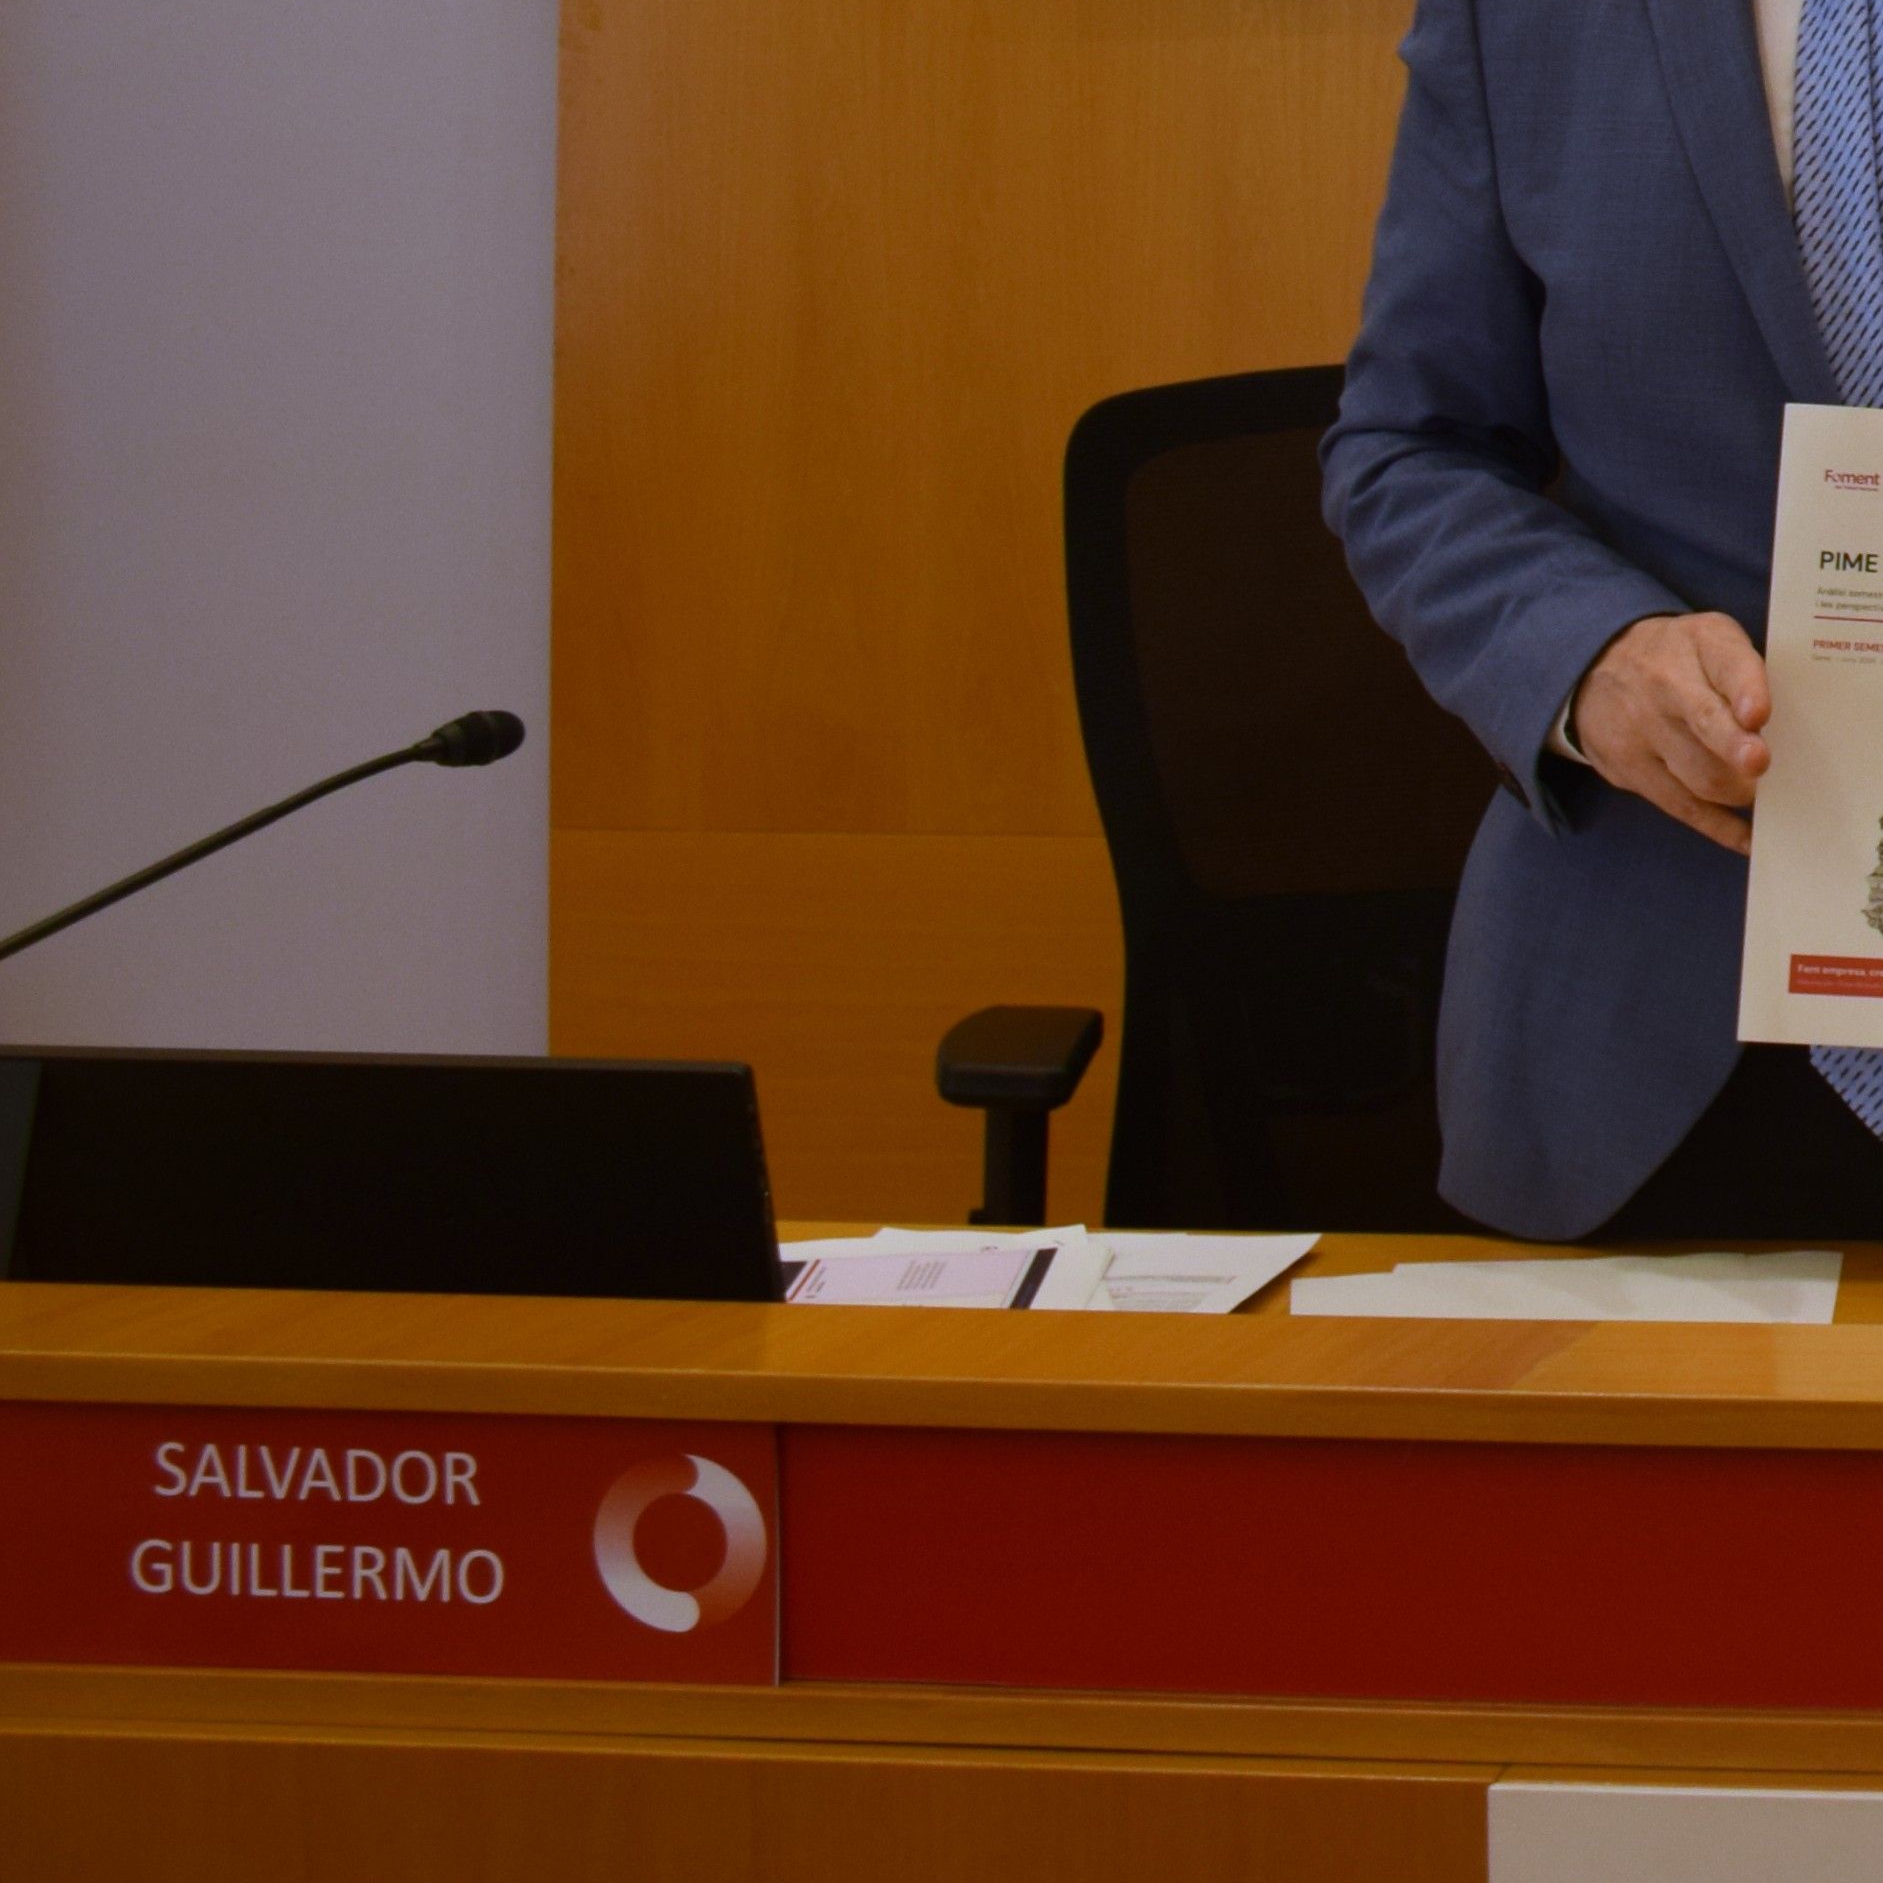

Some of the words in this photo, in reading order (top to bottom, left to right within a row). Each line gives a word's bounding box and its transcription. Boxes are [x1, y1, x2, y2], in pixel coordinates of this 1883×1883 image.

[1820, 551, 1879, 573] PIME
[1813, 639, 1852, 651] PRIMER
[155, 1441, 481, 1506] SALVADOR
[131, 1539, 505, 1605] GUILLERMO
